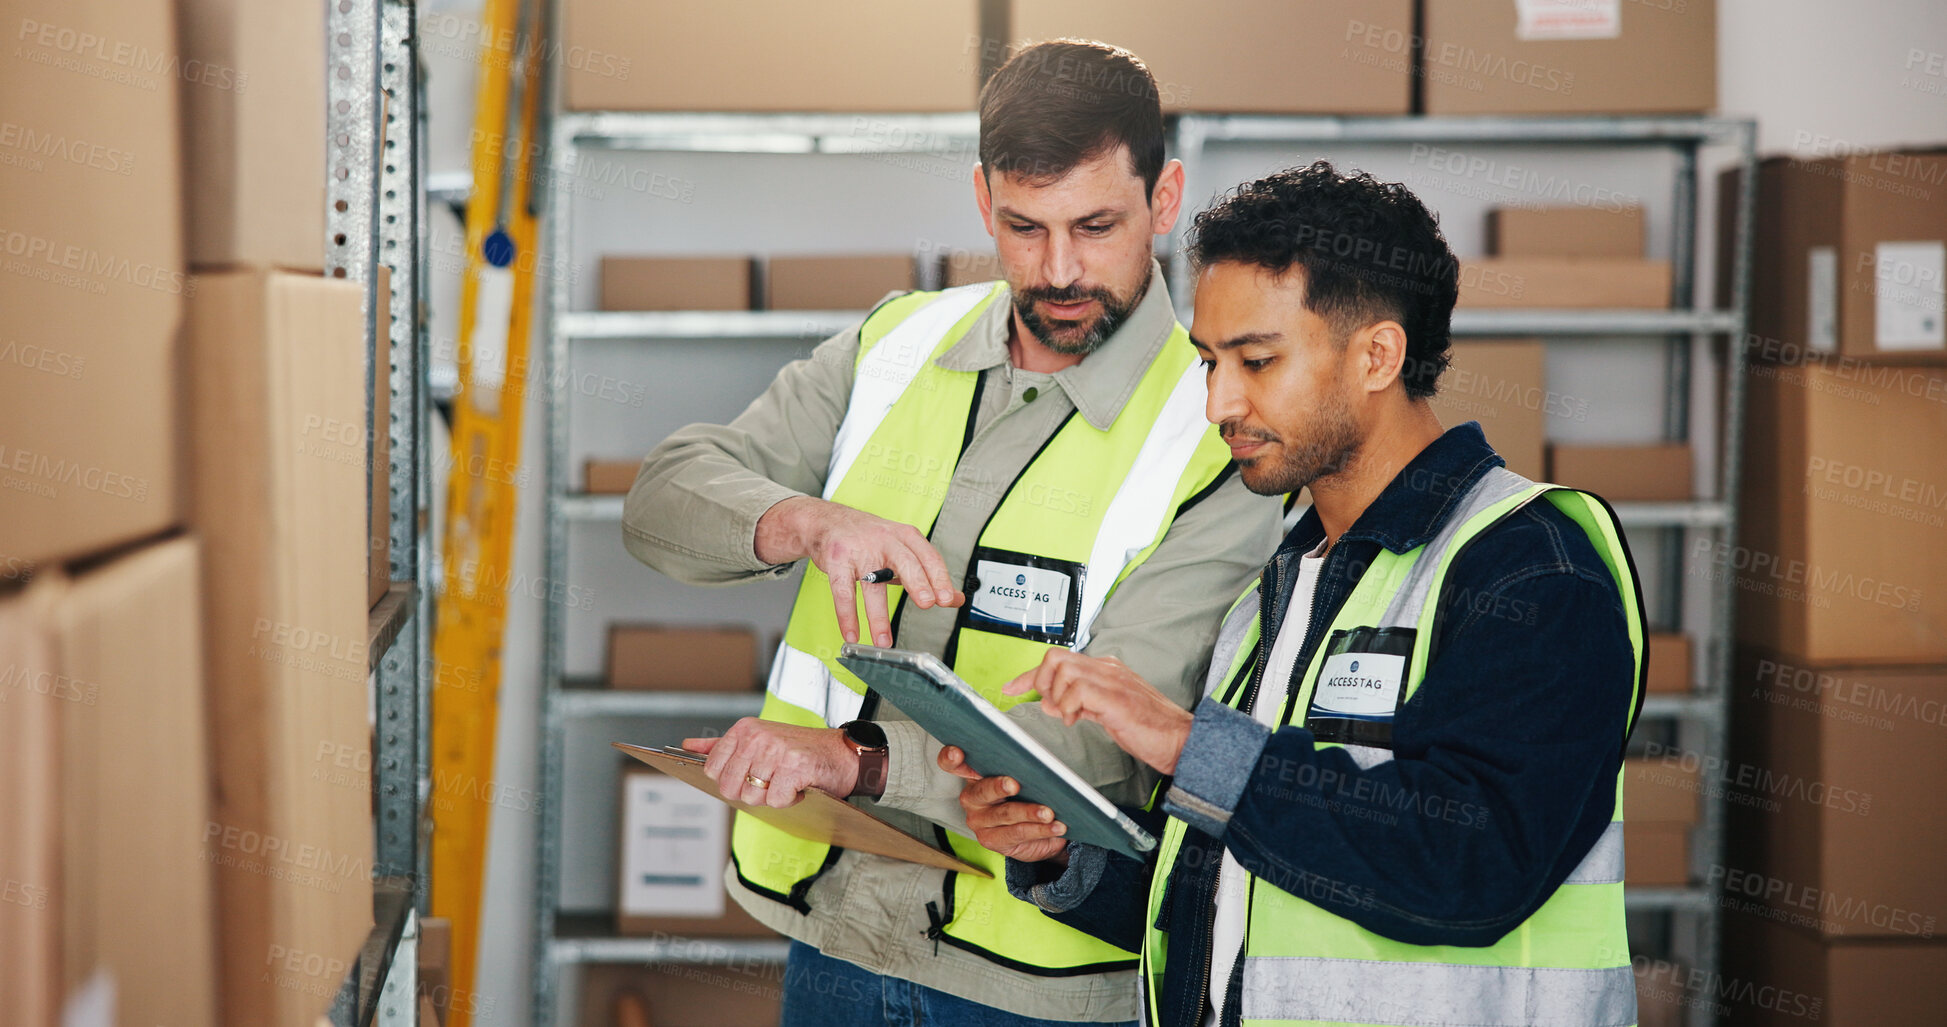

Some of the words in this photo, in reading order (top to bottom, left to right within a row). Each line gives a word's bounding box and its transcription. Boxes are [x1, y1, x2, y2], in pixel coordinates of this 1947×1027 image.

[989, 586, 1027, 600] ACCESS
[1032, 591, 1050, 603] AG
[1327, 676, 1358, 687] ACCESS
[1359, 678, 1382, 690] TAG
